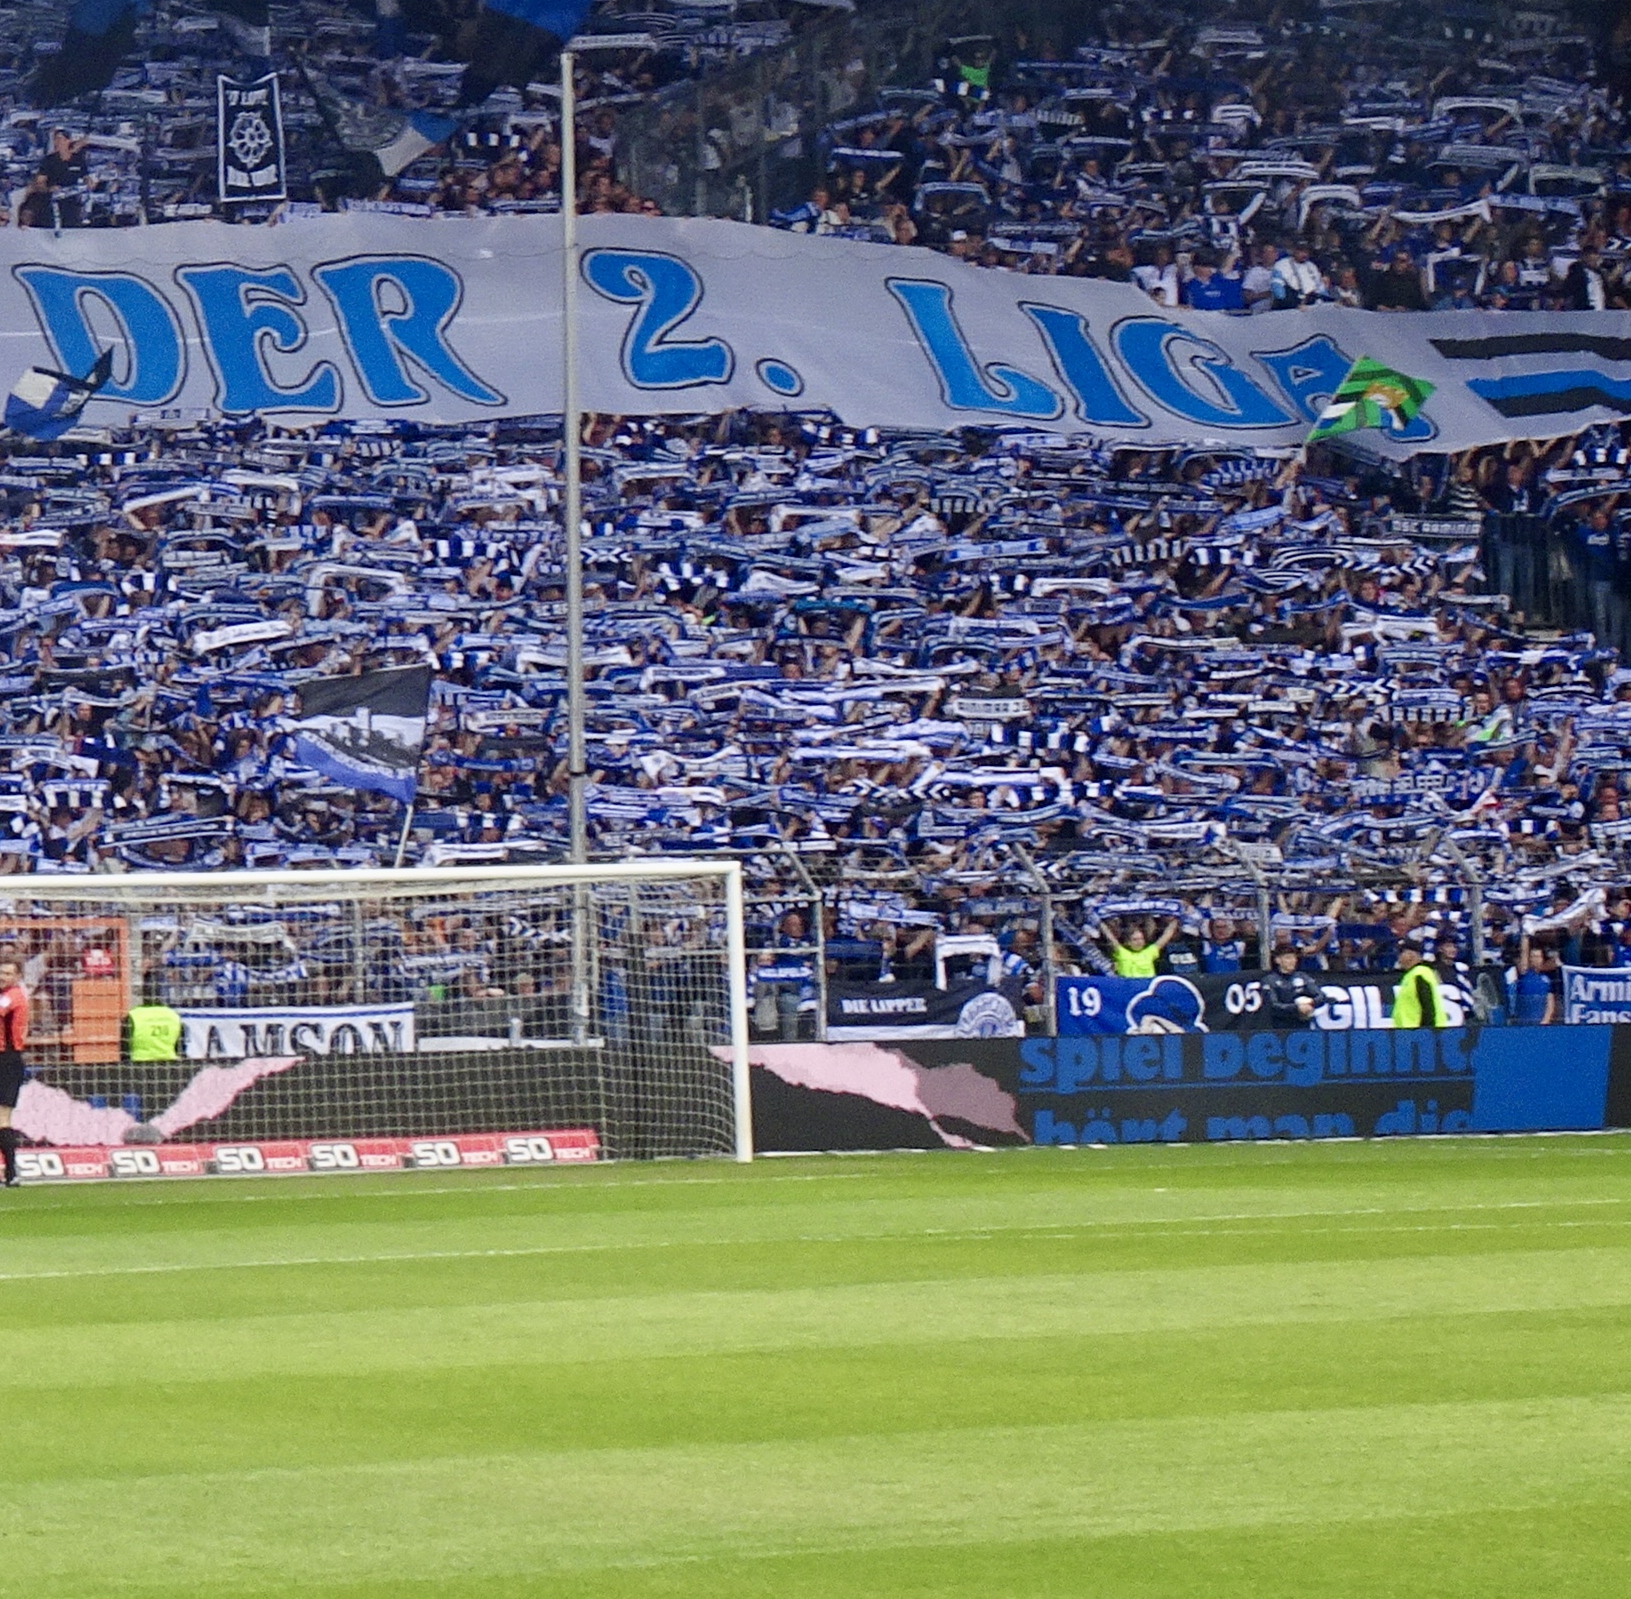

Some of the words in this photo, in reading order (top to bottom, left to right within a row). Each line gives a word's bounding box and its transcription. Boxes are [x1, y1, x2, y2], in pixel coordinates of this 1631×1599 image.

[12, 253, 508, 415] DER
[579, 246, 805, 400] 2.
[841, 999, 871, 1014] DIE
[1067, 986, 1102, 1017] 19
[1224, 981, 1263, 1015] 05
[112, 1149, 161, 1174] SO
[162, 1160, 199, 1173] TECH
[215, 1146, 265, 1171] SO
[266, 1157, 303, 1169] TECH
[310, 1143, 360, 1168] SO
[361, 1154, 398, 1167] TECH
[412, 1141, 461, 1166] SO
[461, 1150, 498, 1164] TECH
[505, 1137, 554, 1162] SO
[555, 1147, 592, 1159] TECH
[15, 1152, 64, 1178] SO
[66, 1162, 103, 1176] TECH
